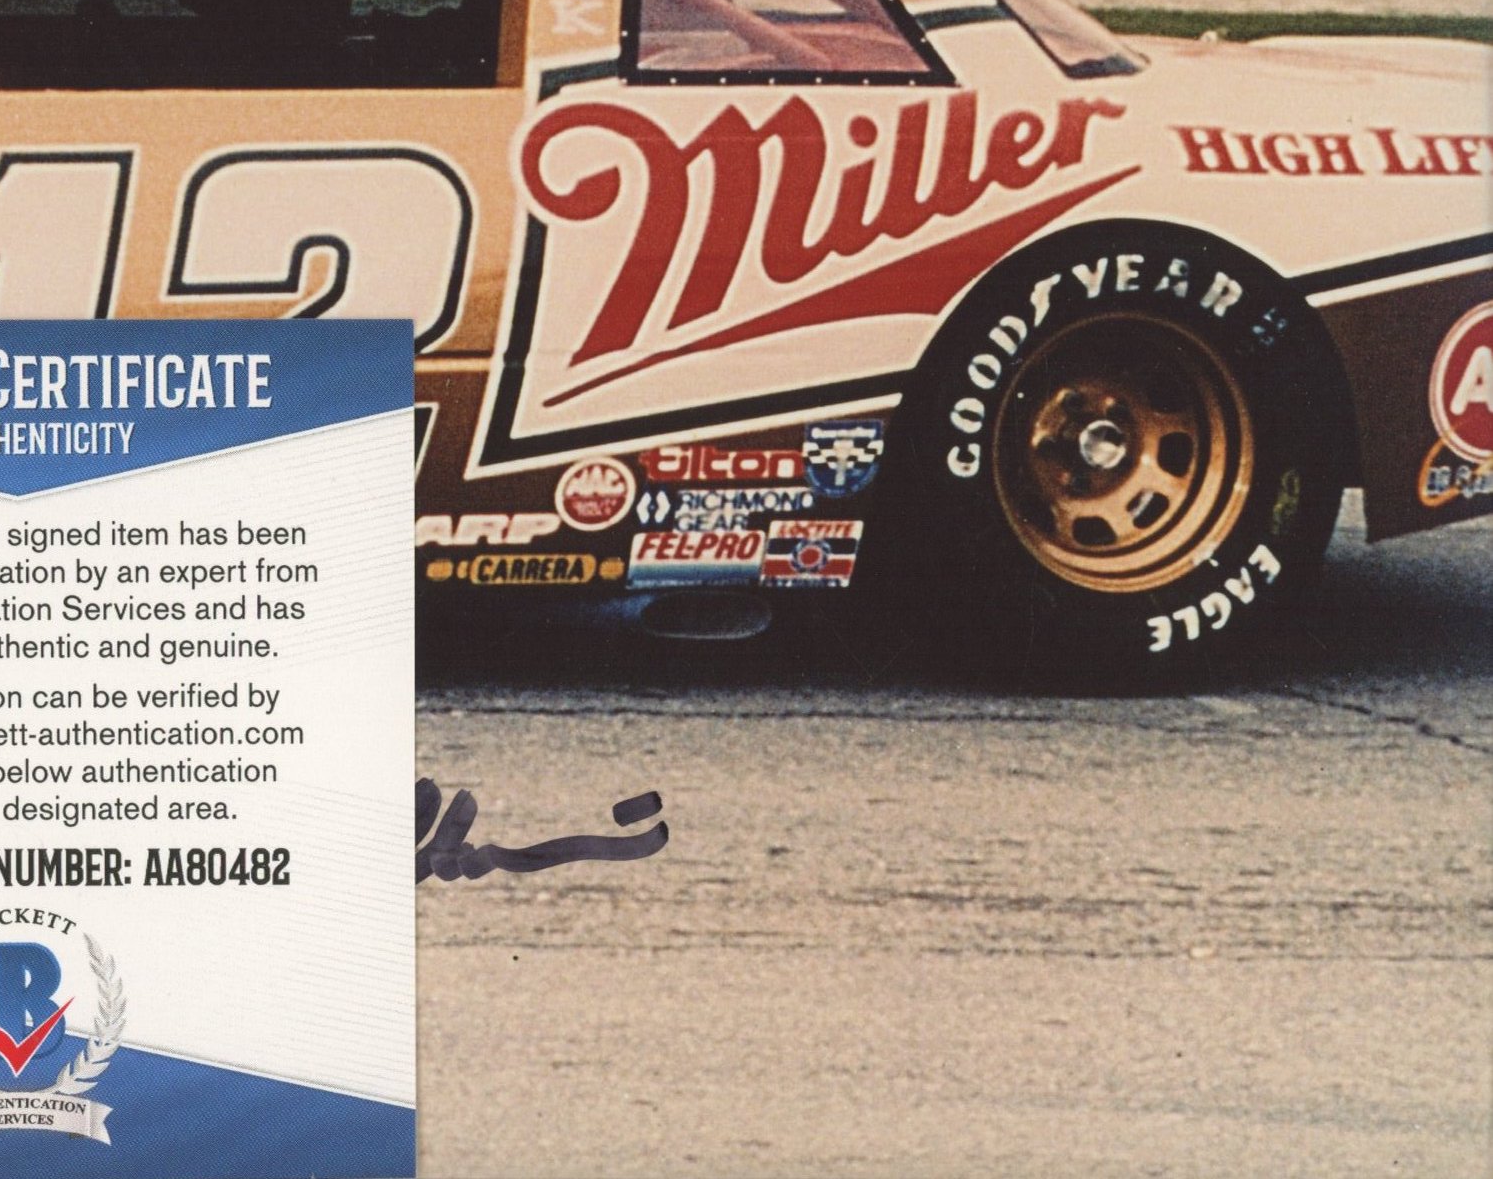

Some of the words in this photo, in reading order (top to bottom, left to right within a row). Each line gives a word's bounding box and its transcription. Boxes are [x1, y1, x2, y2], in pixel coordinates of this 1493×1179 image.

[1167, 124, 1364, 176] HIGH
[1365, 127, 1493, 177] LIF
[520, 91, 1127, 369] Miller
[7, 520, 101, 554] signed
[111, 520, 168, 546] item
[180, 520, 228, 546] has
[238, 520, 306, 546] been
[775, 520, 855, 538] LOCTITE
[636, 531, 763, 562] FEL-PRO
[76, 558, 108, 591] by
[117, 565, 149, 584] an
[159, 560, 247, 590] expert
[255, 557, 318, 583] from
[477, 558, 584, 582] CARRERA
[62, 594, 186, 622] Services
[195, 594, 246, 620] and
[257, 594, 305, 620] has
[98, 633, 150, 659] and
[160, 632, 278, 665] genuine.
[32, 690, 82, 709] can
[93, 683, 128, 709] be
[137, 682, 238, 708] verified
[249, 682, 280, 715] by
[81, 757, 277, 784] authentication
[3, 795, 158, 827] designated
[168, 801, 237, 820] area.
[143, 847, 290, 886] AA80482
